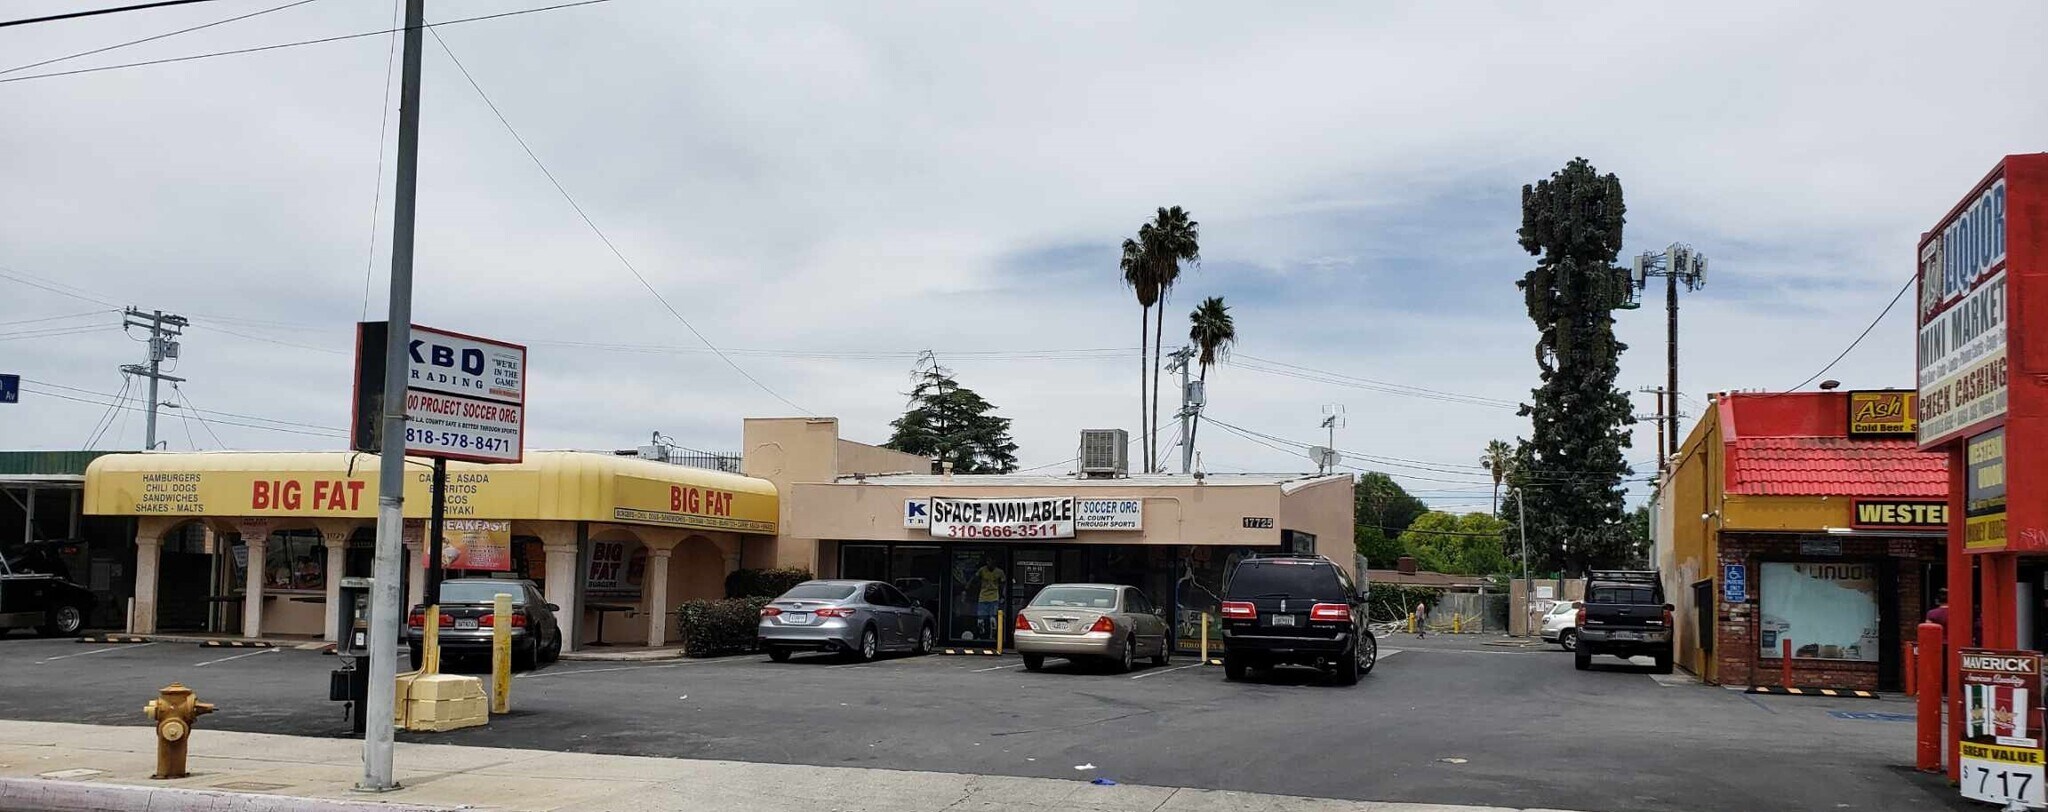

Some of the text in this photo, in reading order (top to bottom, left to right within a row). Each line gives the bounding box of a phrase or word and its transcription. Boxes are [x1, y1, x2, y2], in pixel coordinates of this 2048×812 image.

[1944, 181, 2005, 300] LIQUOR
[1920, 277, 2005, 371] MINI MARKET
[409, 340, 484, 376] KBD
[411, 369, 483, 389] RADING
[1919, 385, 1951, 423] CHECK
[1955, 357, 2006, 407] CASHING
[407, 395, 518, 424] 00 PROJECT SOCCER ORG.
[1855, 396, 1901, 422] Ash
[425, 418, 445, 426] COUNTY
[445, 420, 457, 428] SAFE
[461, 422, 479, 431] BETTER
[479, 424, 501, 433] THROUGH
[405, 428, 509, 452] 818-578-8471
[143, 474, 201, 482] HAMBURGERS
[419, 474, 489, 483] CAE ASADA
[146, 484, 197, 492] CHILI DOGS
[252, 480, 365, 510] BIG FAT
[430, 485, 477, 493] BRRITOS
[143, 494, 199, 502] SANDWICHES
[670, 485, 733, 516] BIG FAT
[136, 504, 169, 512] SHAKES
[177, 504, 204, 512] MALTS
[443, 506, 474, 515] RIYAKI
[908, 501, 928, 517] K
[934, 499, 1071, 523] SPACE AVAILABLE
[1084, 502, 1117, 513] SOCCER
[1120, 502, 1140, 513] ORG.
[443, 520, 509, 532] EAKFAST
[948, 524, 1058, 538] 310-666-3511
[1244, 518, 1272, 528] 17725
[593, 543, 623, 561] BIG
[589, 561, 621, 580] FAT
[1963, 656, 2032, 672] MAVERICK
[1963, 744, 2038, 763] GREAT VALUE
[1977, 767, 2033, 800] 7.17
